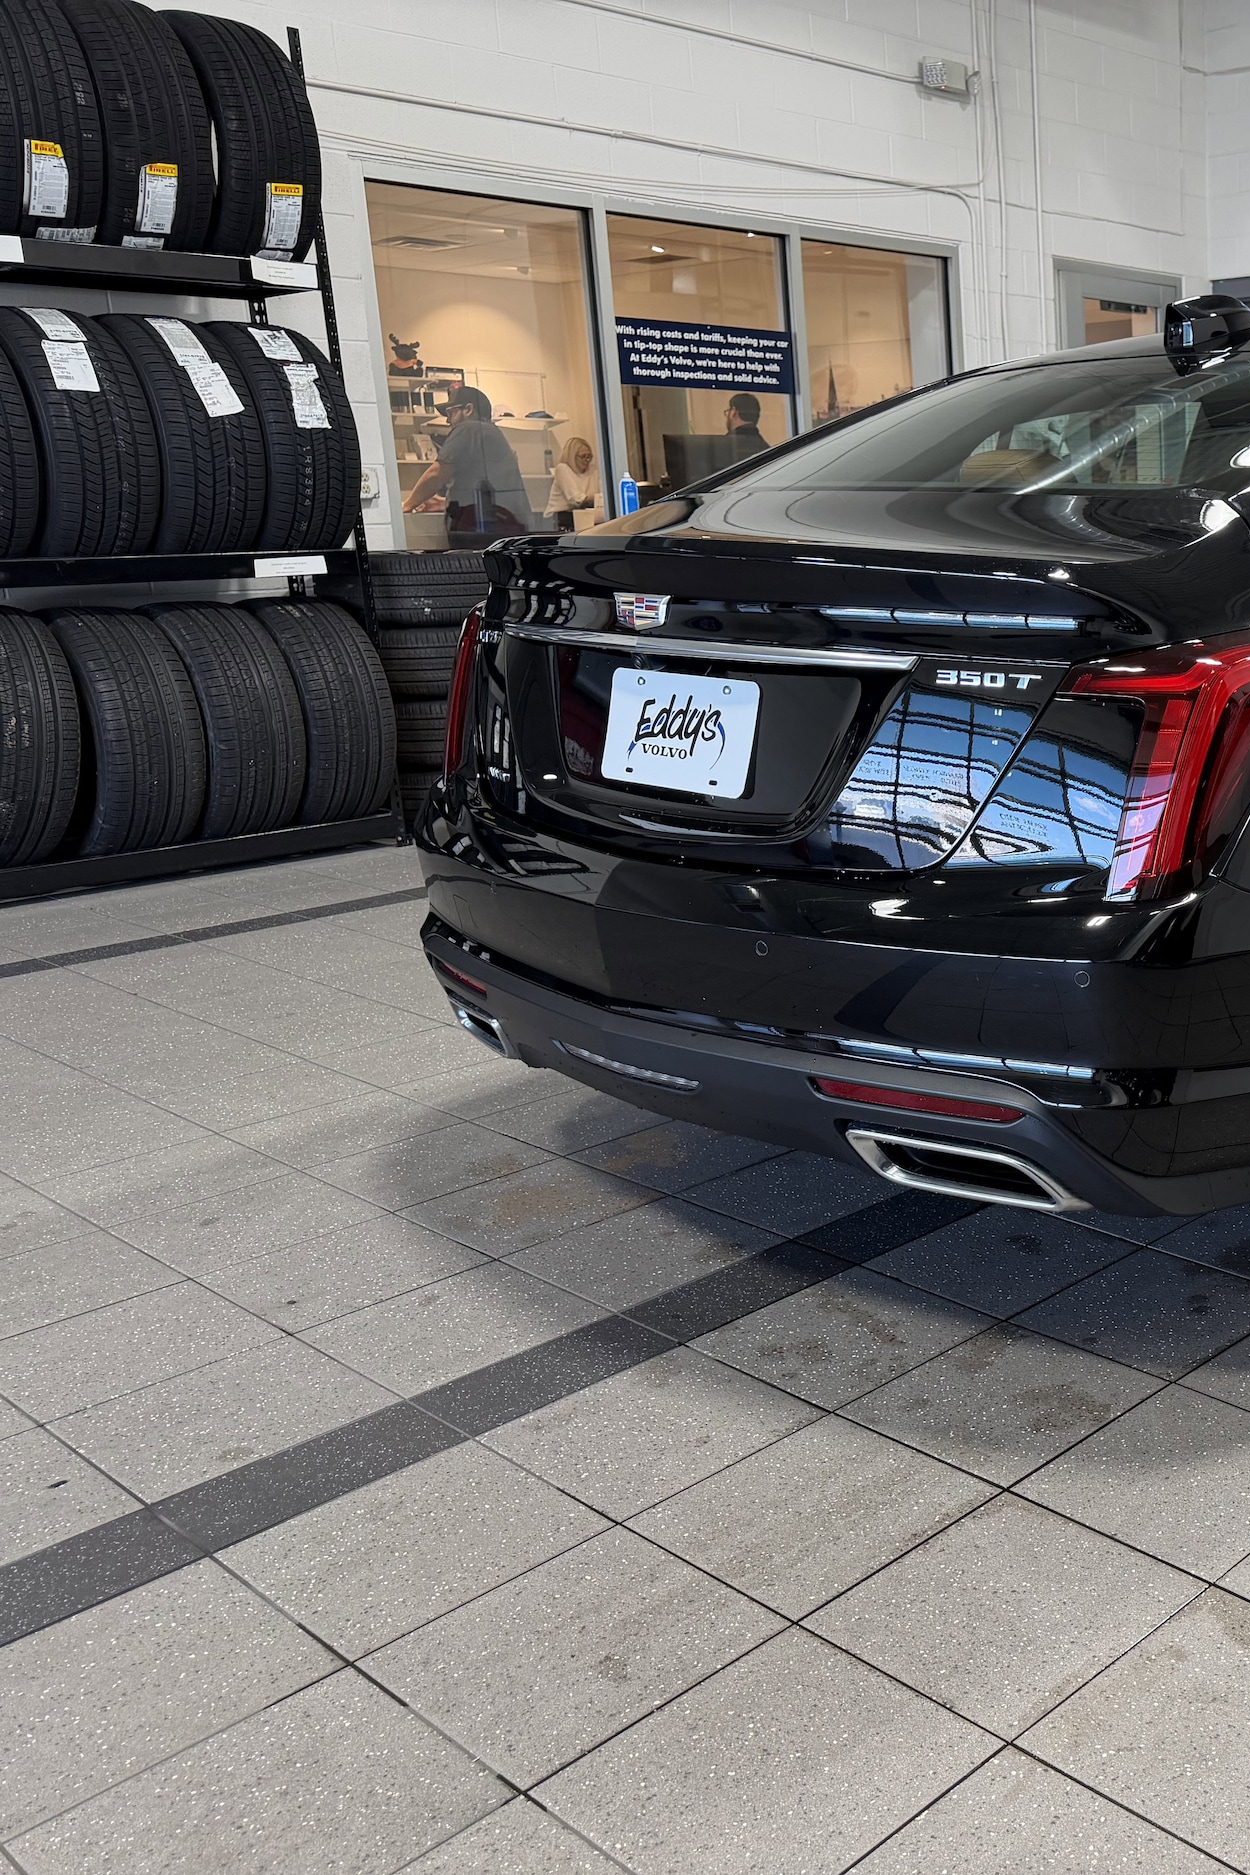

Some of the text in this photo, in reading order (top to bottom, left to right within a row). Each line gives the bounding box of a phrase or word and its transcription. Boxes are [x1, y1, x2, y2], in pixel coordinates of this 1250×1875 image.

[615, 325, 789, 348] With rising costs and tariffs, keeping your car
[623, 339, 784, 360] in tip-top shape is more crucial than ever.
[629, 353, 780, 373] At Eddy's Volvo, we're here to help with
[633, 366, 780, 385] thorough inspections and solid advice.
[634, 693, 722, 757] Eddy's
[641, 742, 688, 760] VOLVO
